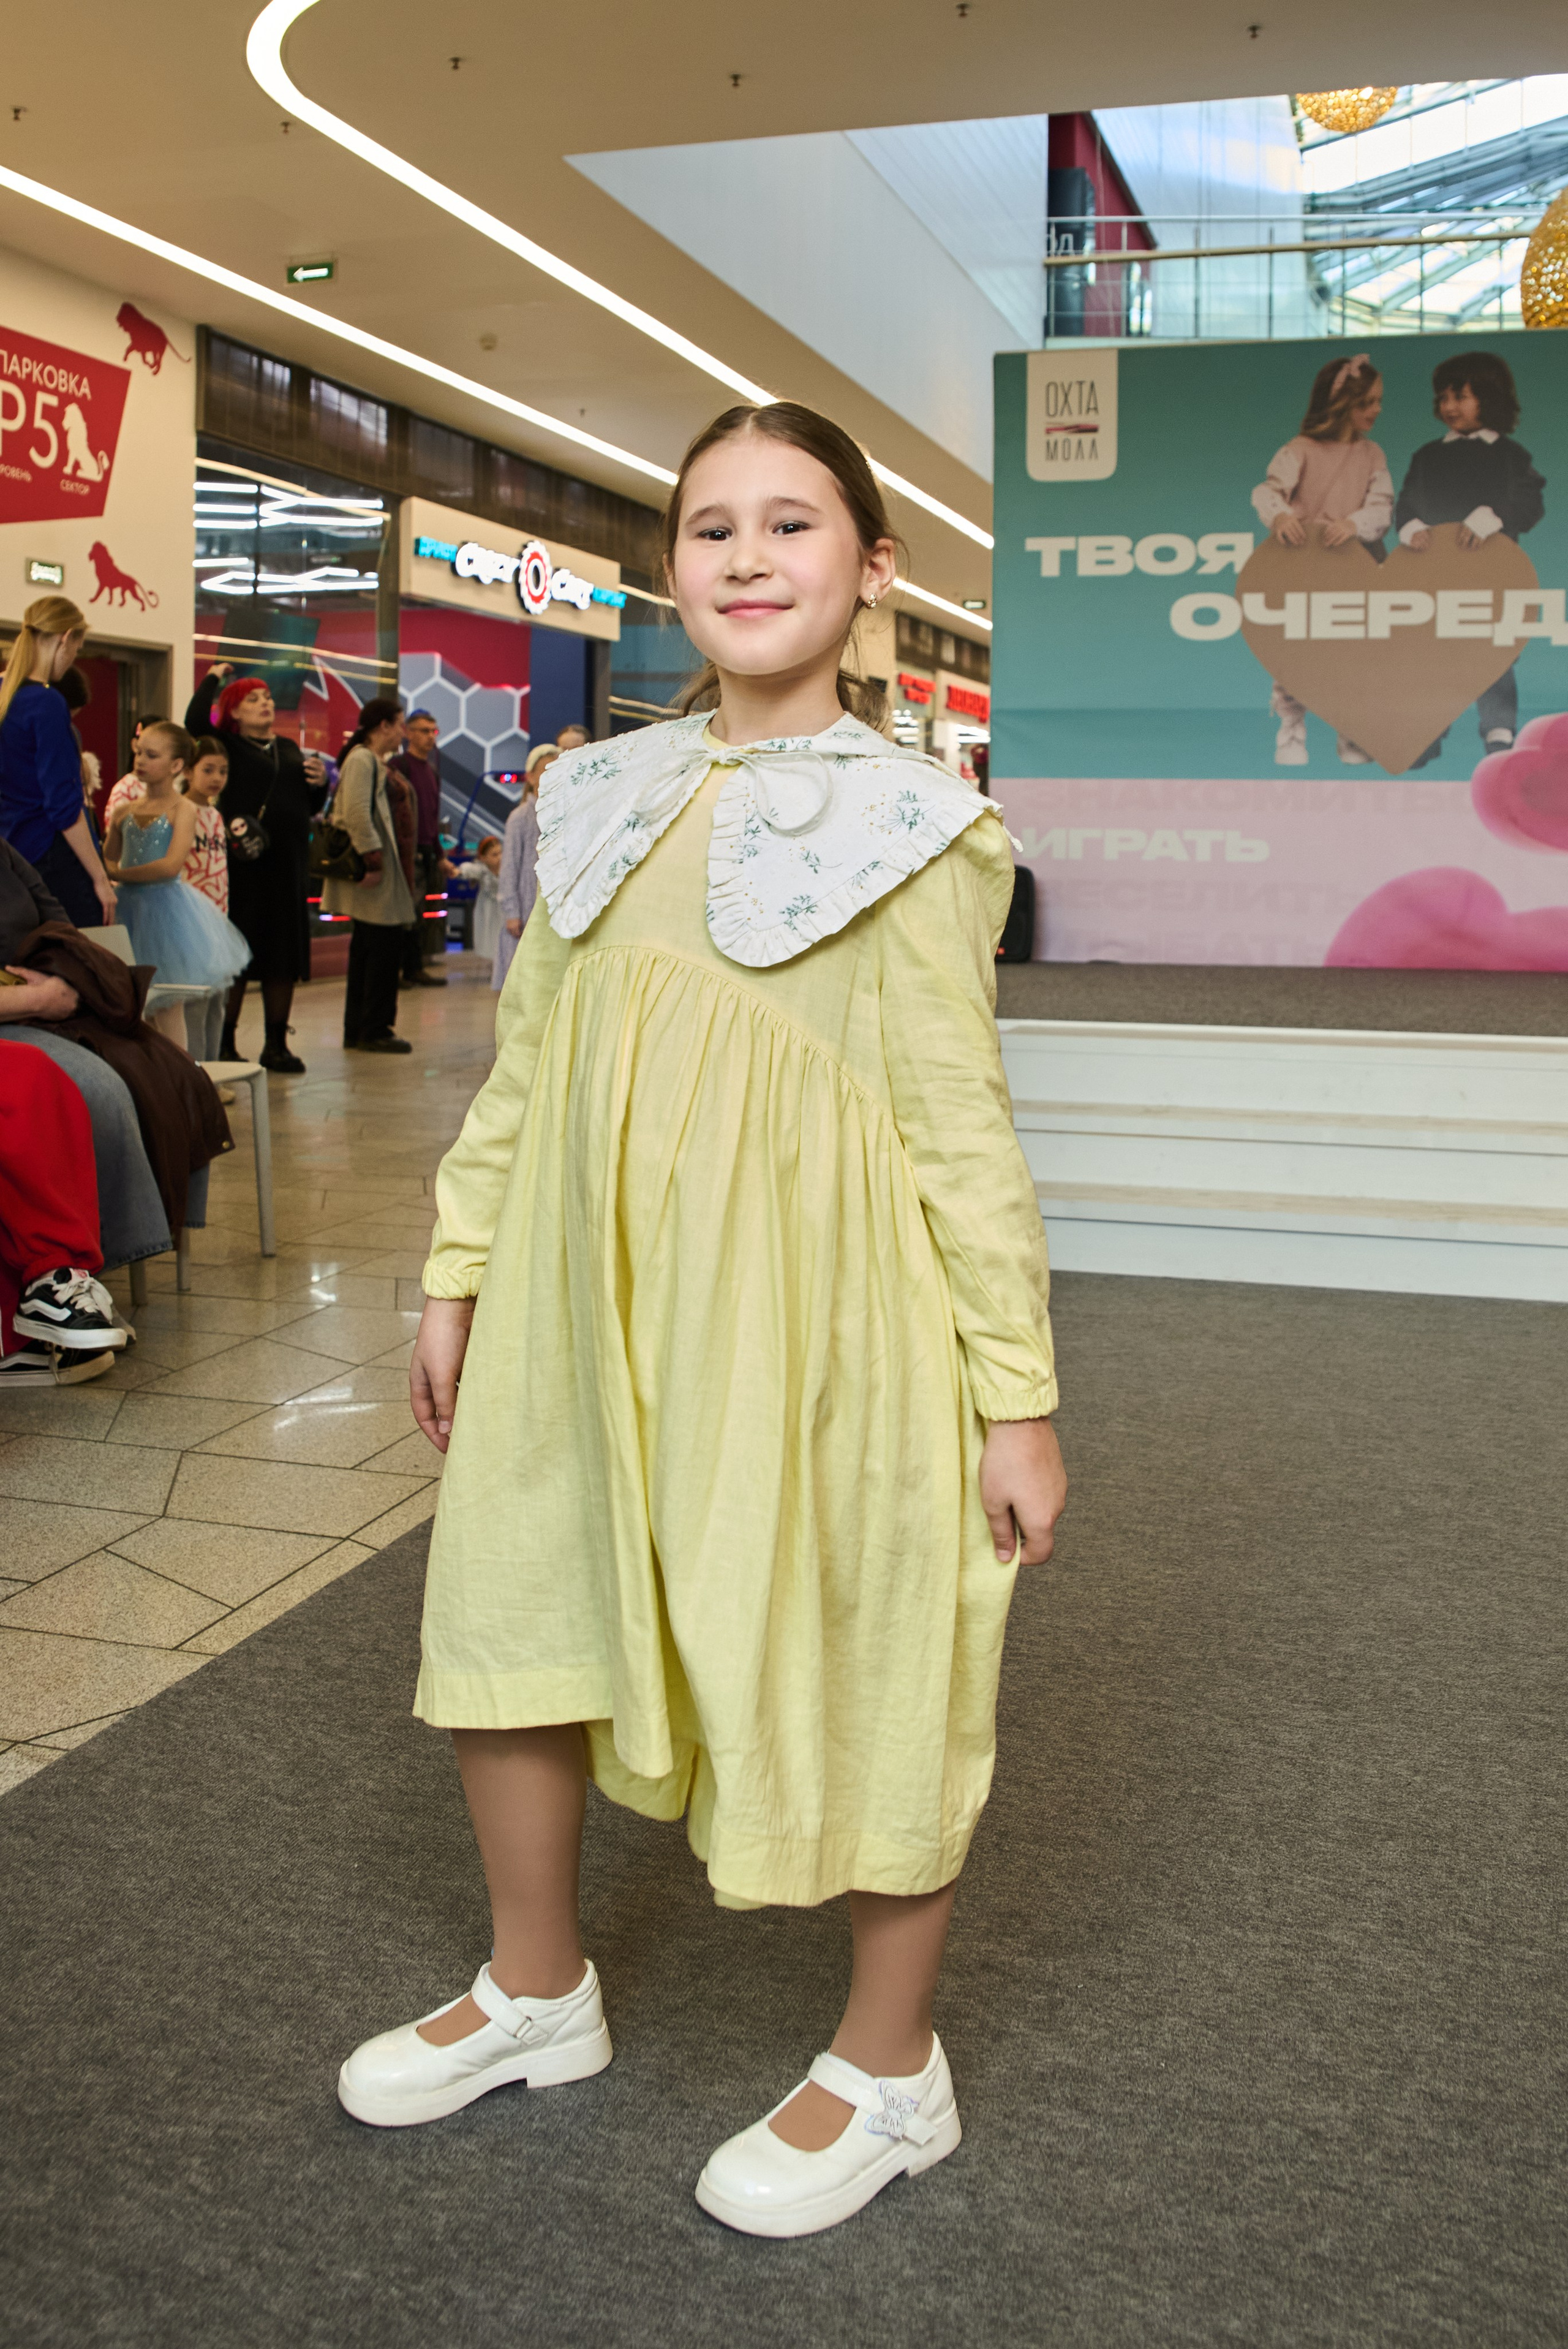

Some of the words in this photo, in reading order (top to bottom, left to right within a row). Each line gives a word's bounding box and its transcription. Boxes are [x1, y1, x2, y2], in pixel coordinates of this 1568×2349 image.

[1044, 380, 1099, 418] ОХТА
[0, 379, 59, 469] P5
[1044, 437, 1099, 461] МОЛЛ
[59, 479, 91, 496] СЕКТОР
[1025, 532, 1254, 577] ТВОЯ
[1021, 826, 1271, 863] ИГРАТЬ
